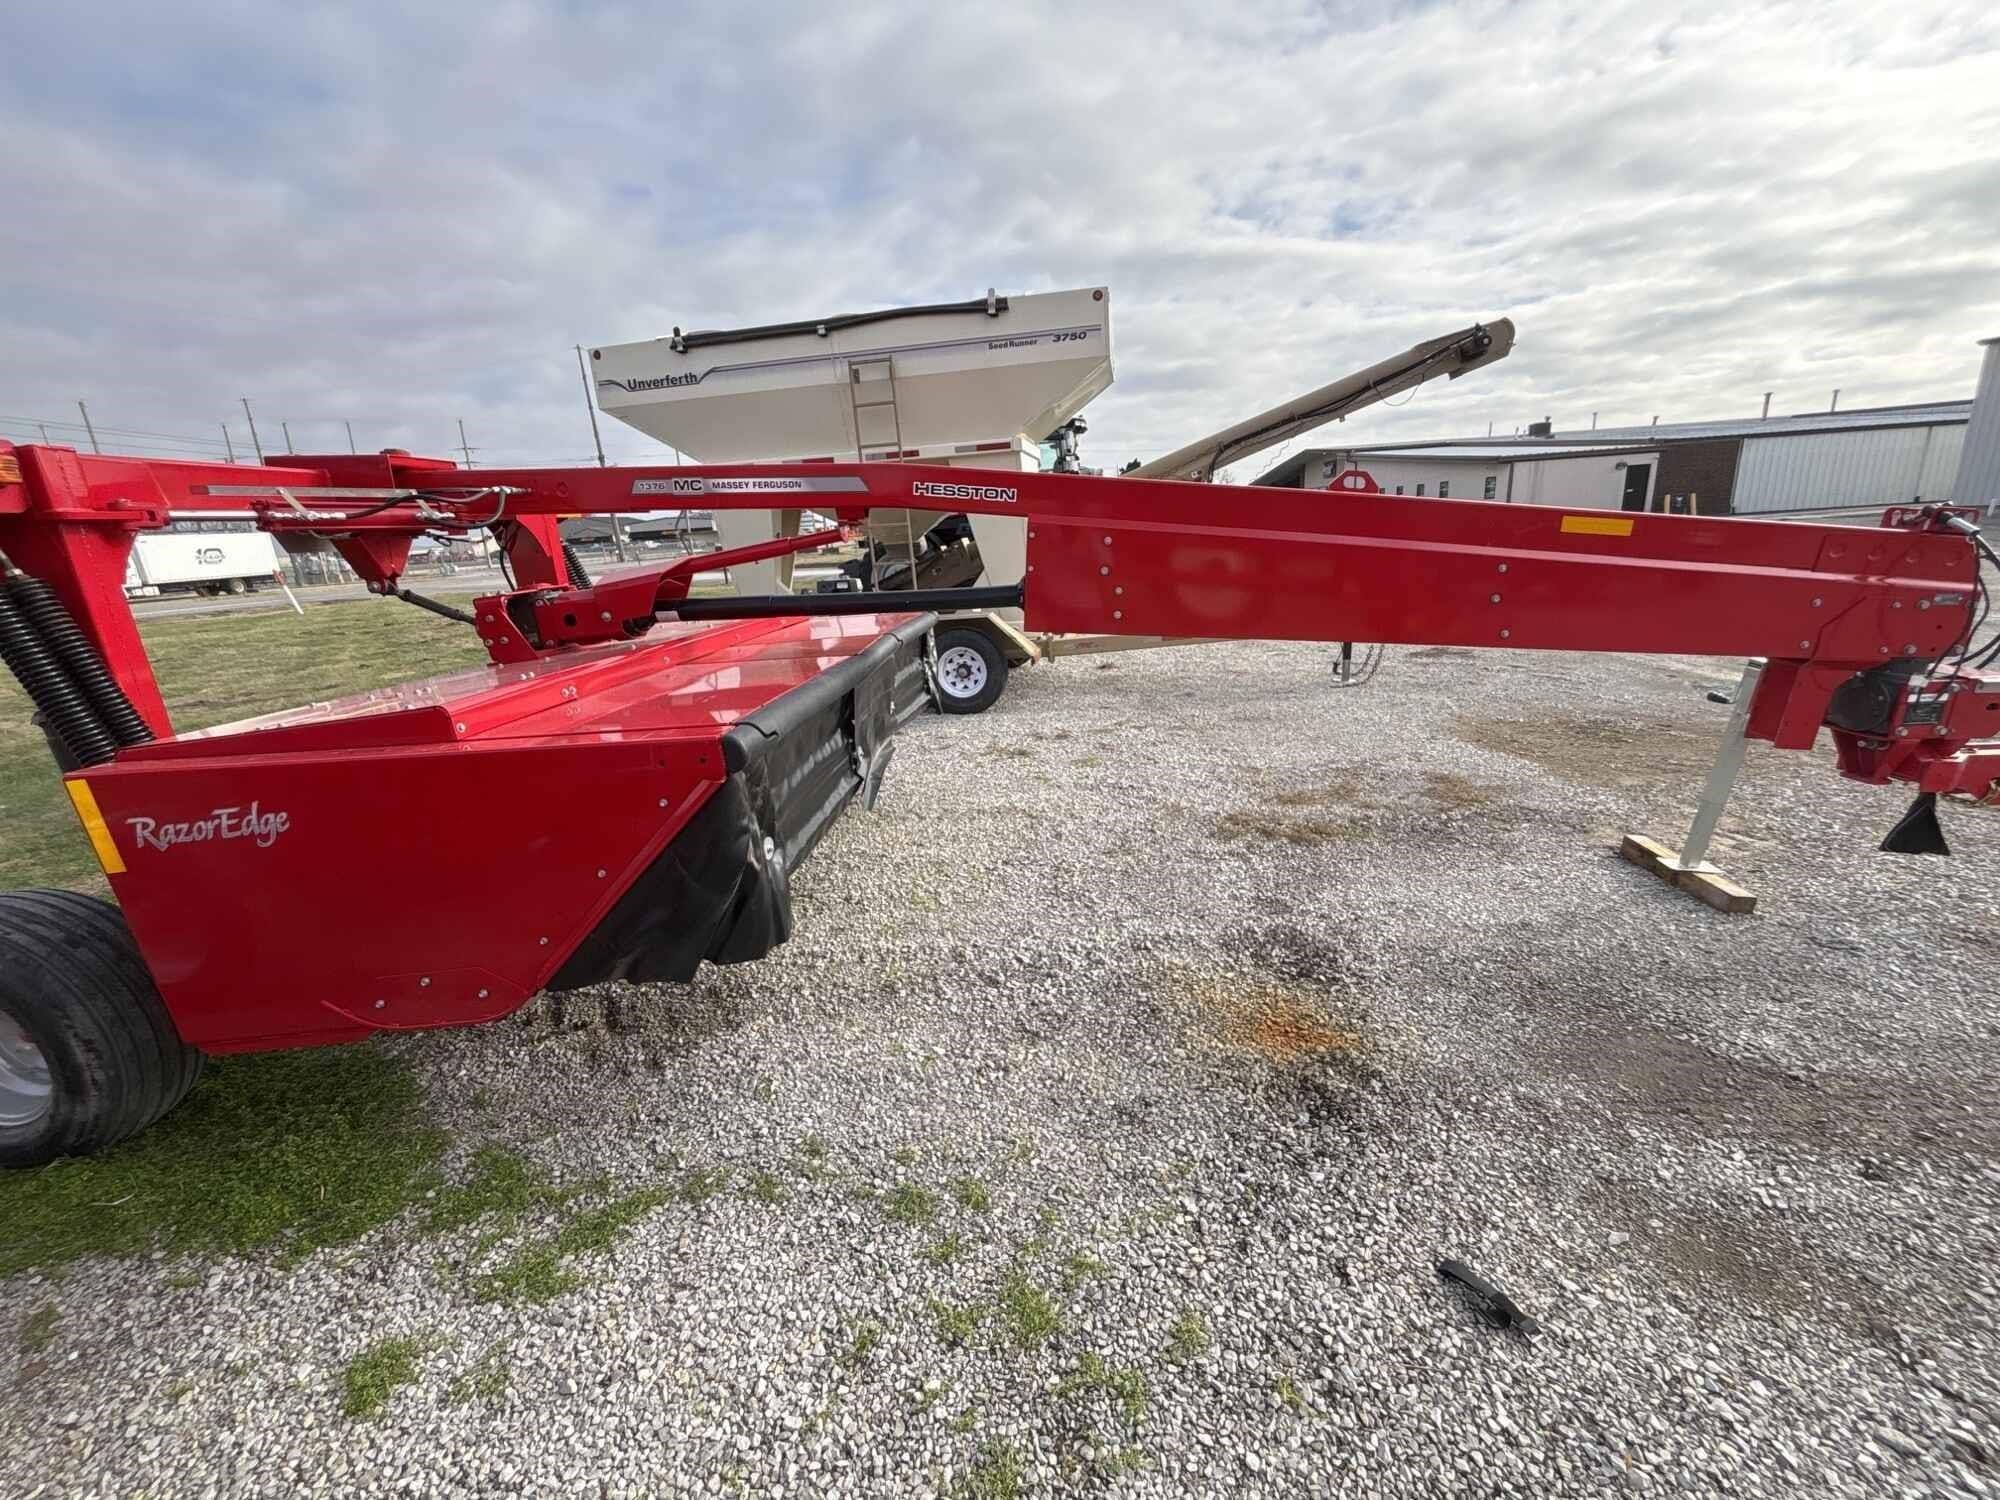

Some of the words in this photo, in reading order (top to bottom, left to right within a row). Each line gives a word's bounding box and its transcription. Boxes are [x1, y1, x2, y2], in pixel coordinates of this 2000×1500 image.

[1052, 331, 1087, 343] 3750
[627, 372, 698, 390] Unverferth
[674, 480, 702, 491] MC
[712, 481, 749, 489] MASSEY
[752, 480, 802, 489] FERGUSON
[913, 481, 1017, 502] HESSTON
[125, 800, 290, 852] RazorEdge
